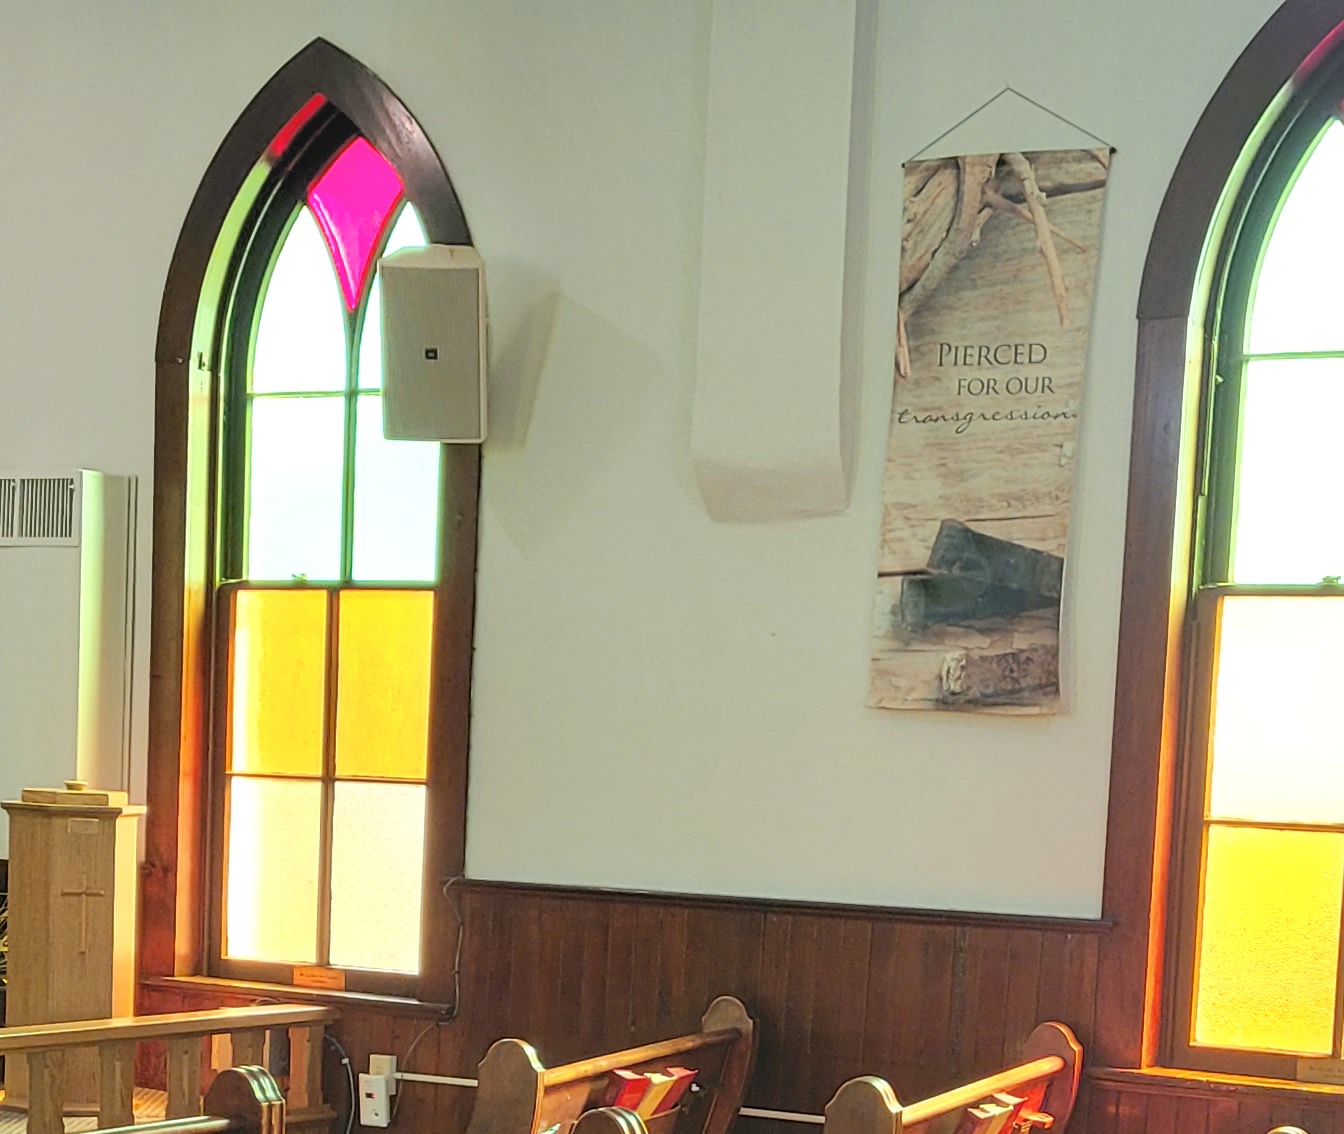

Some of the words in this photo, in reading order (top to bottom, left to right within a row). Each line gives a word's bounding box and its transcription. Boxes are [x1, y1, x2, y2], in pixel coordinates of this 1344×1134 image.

[938, 342, 1048, 367] PIERCED
[957, 377, 1000, 396] FOR
[1005, 376, 1056, 396] OUR
